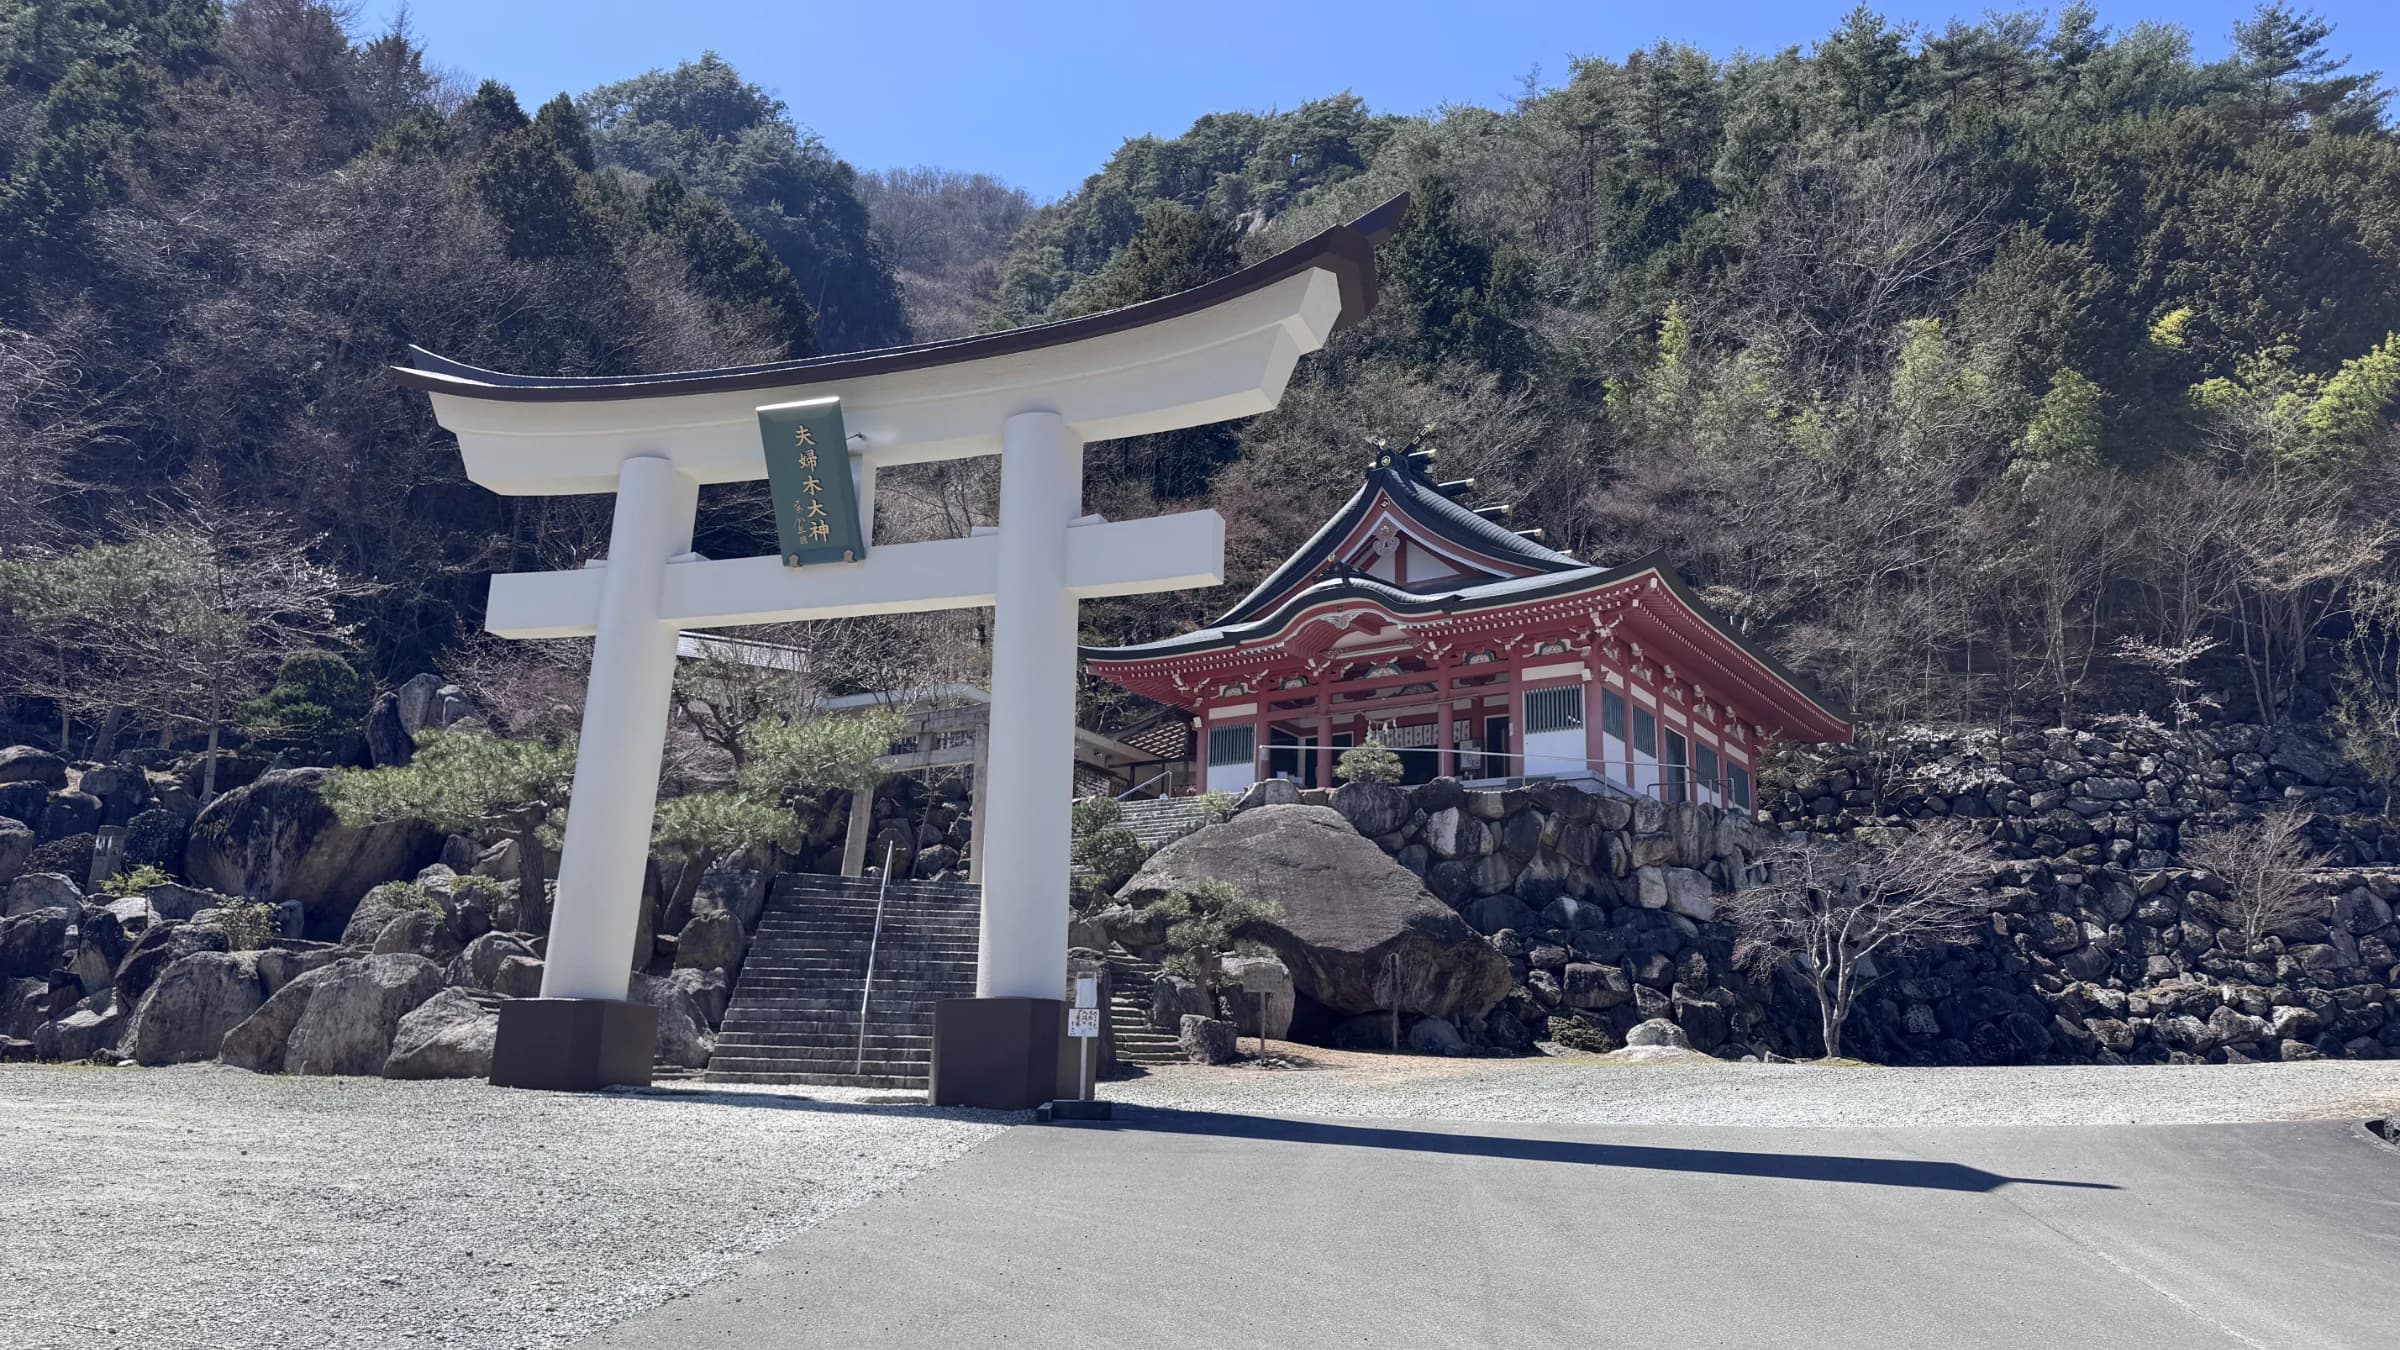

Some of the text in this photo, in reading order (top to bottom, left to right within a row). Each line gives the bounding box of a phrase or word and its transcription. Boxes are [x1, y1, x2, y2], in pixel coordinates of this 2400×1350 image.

[795, 425, 831, 544] 夫婦木大神
